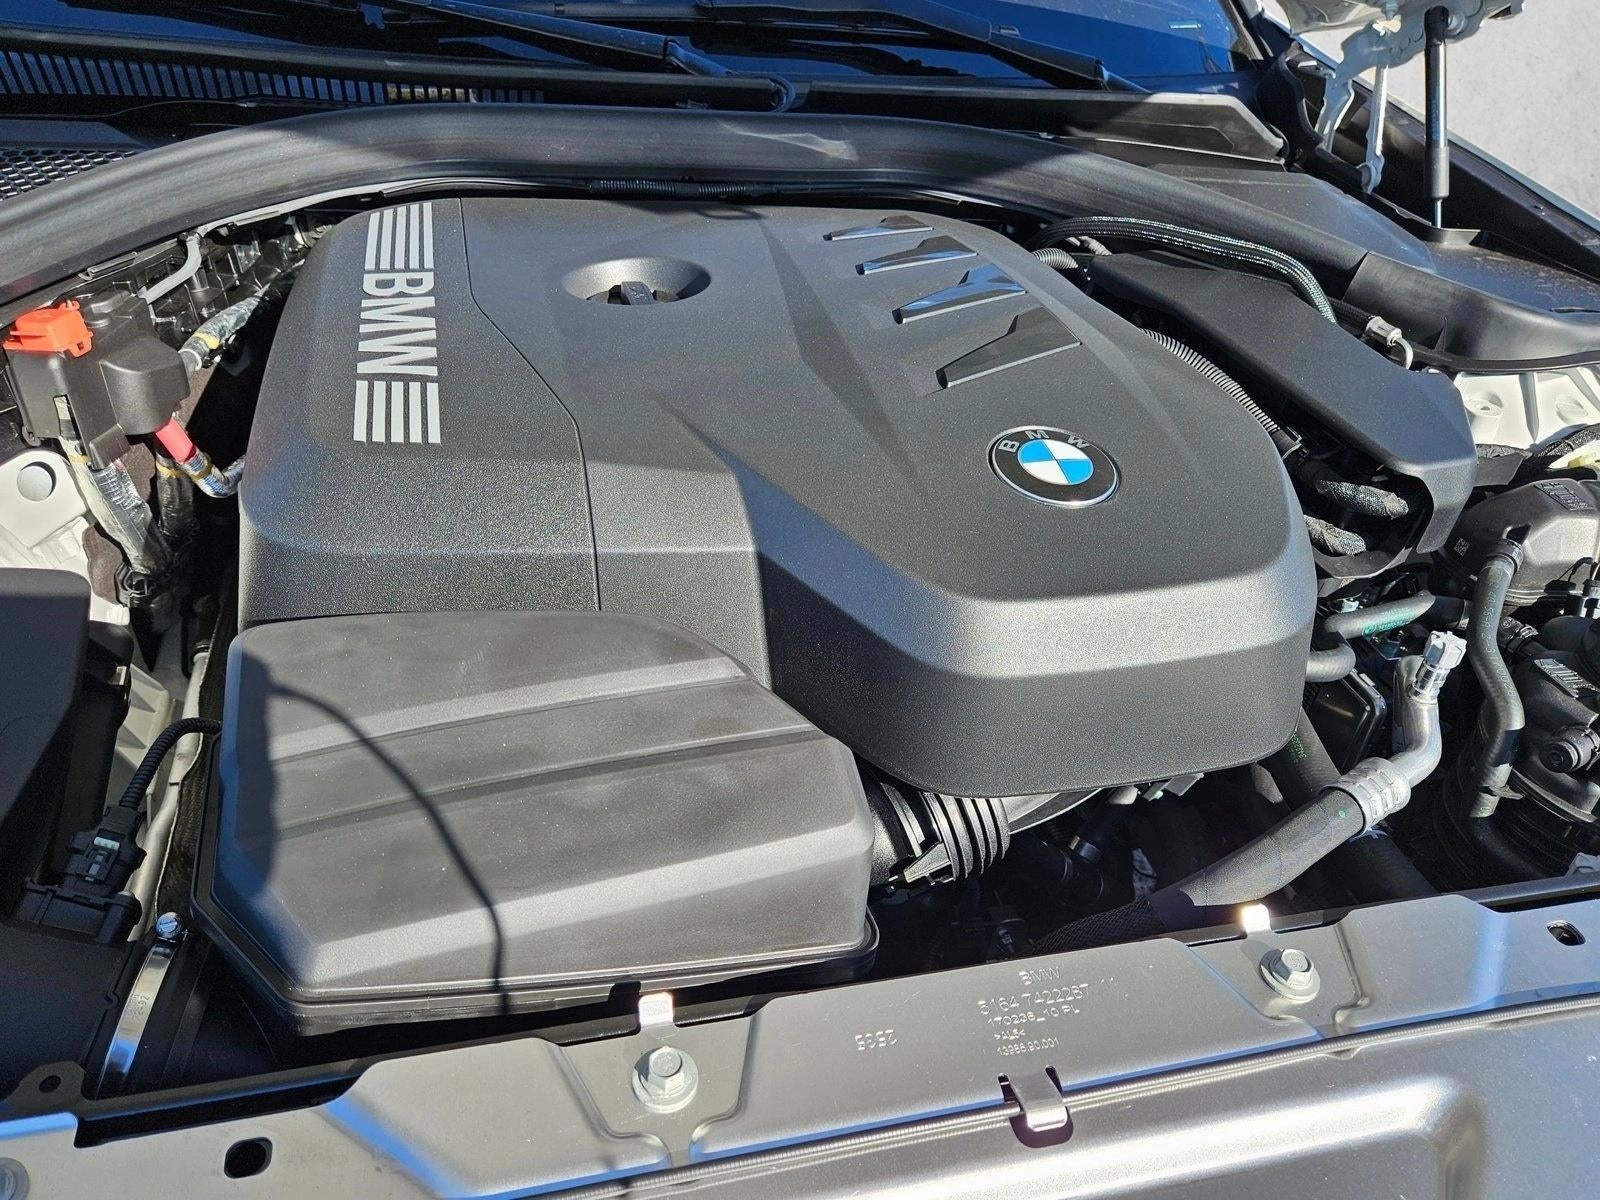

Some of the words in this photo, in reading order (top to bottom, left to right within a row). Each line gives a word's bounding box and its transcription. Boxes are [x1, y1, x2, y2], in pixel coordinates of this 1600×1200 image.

[357, 272, 438, 376] BMW
[998, 429, 1090, 453] BMW
[1019, 966, 1060, 985] BMW
